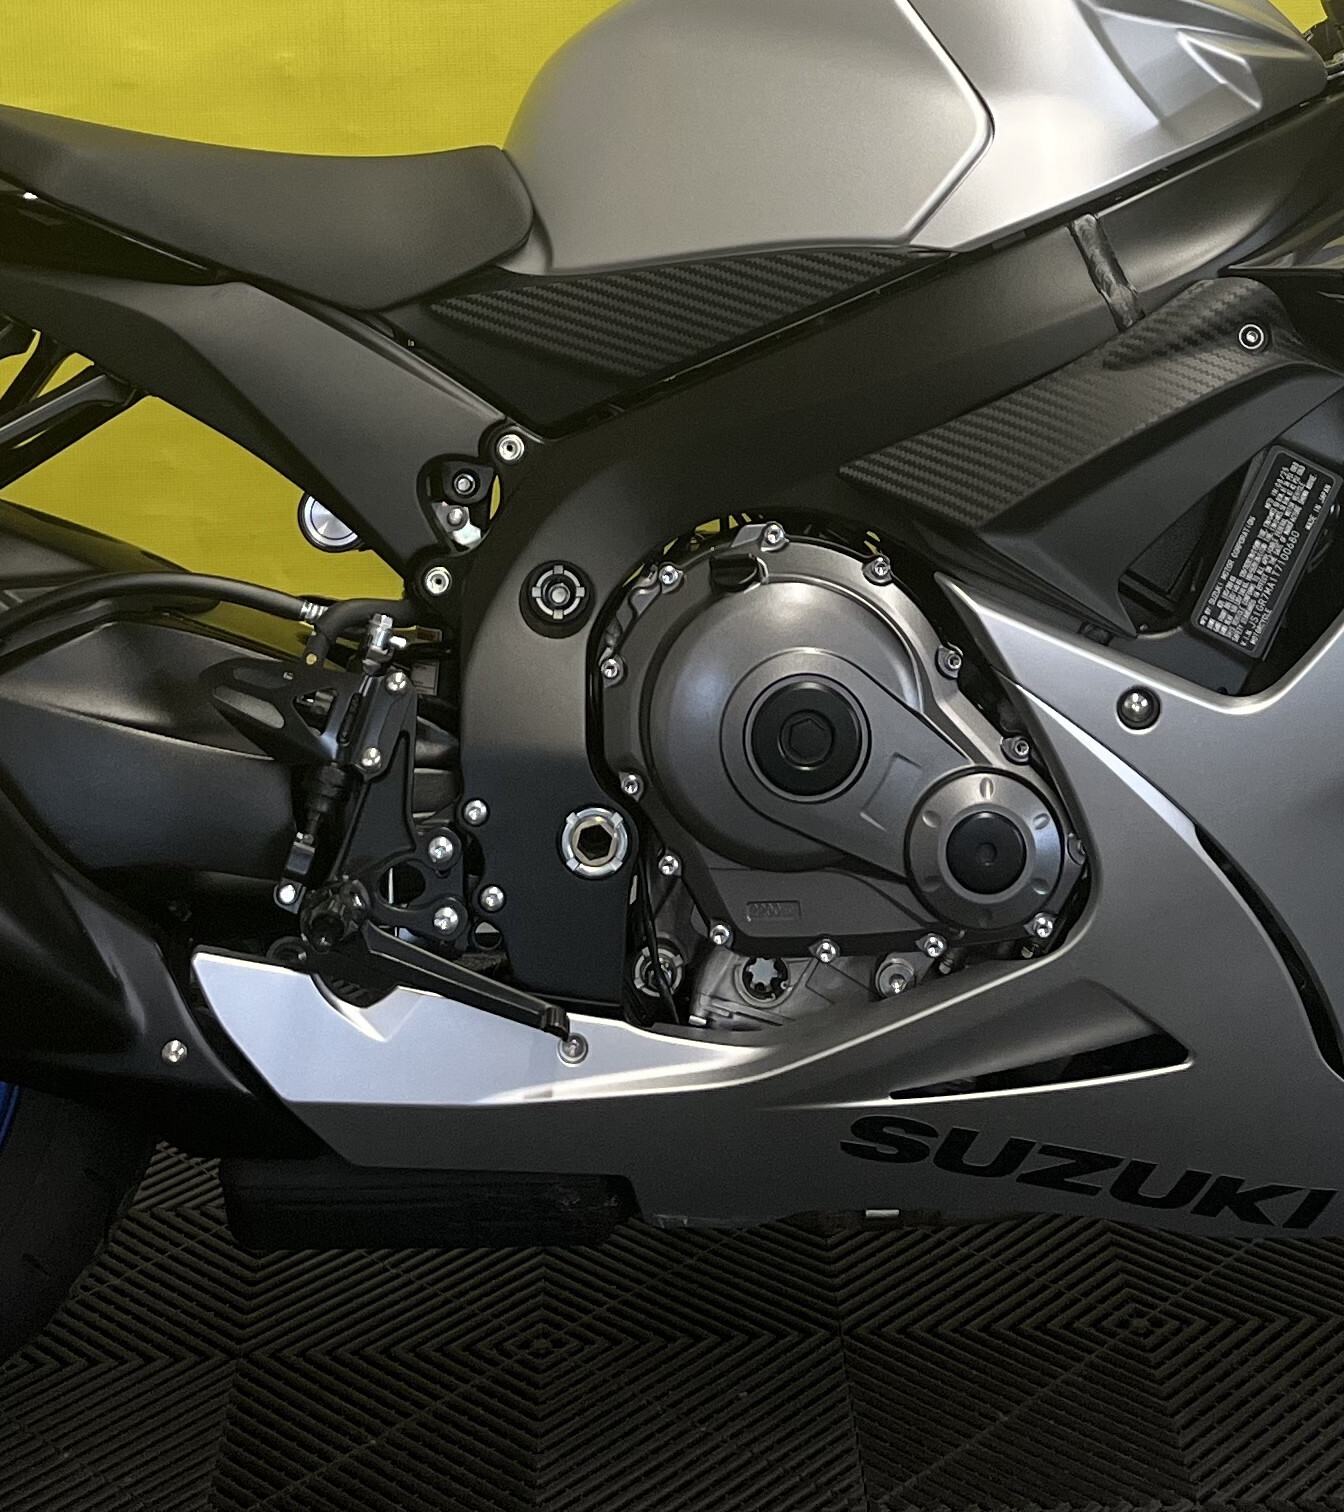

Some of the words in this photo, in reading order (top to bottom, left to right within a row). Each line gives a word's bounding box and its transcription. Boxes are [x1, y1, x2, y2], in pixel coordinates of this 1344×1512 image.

[1207, 581, 1224, 606] SUZUKI
[1230, 515, 1256, 559] CORPORATION
[840, 1114, 1338, 1230] SUZUKI
